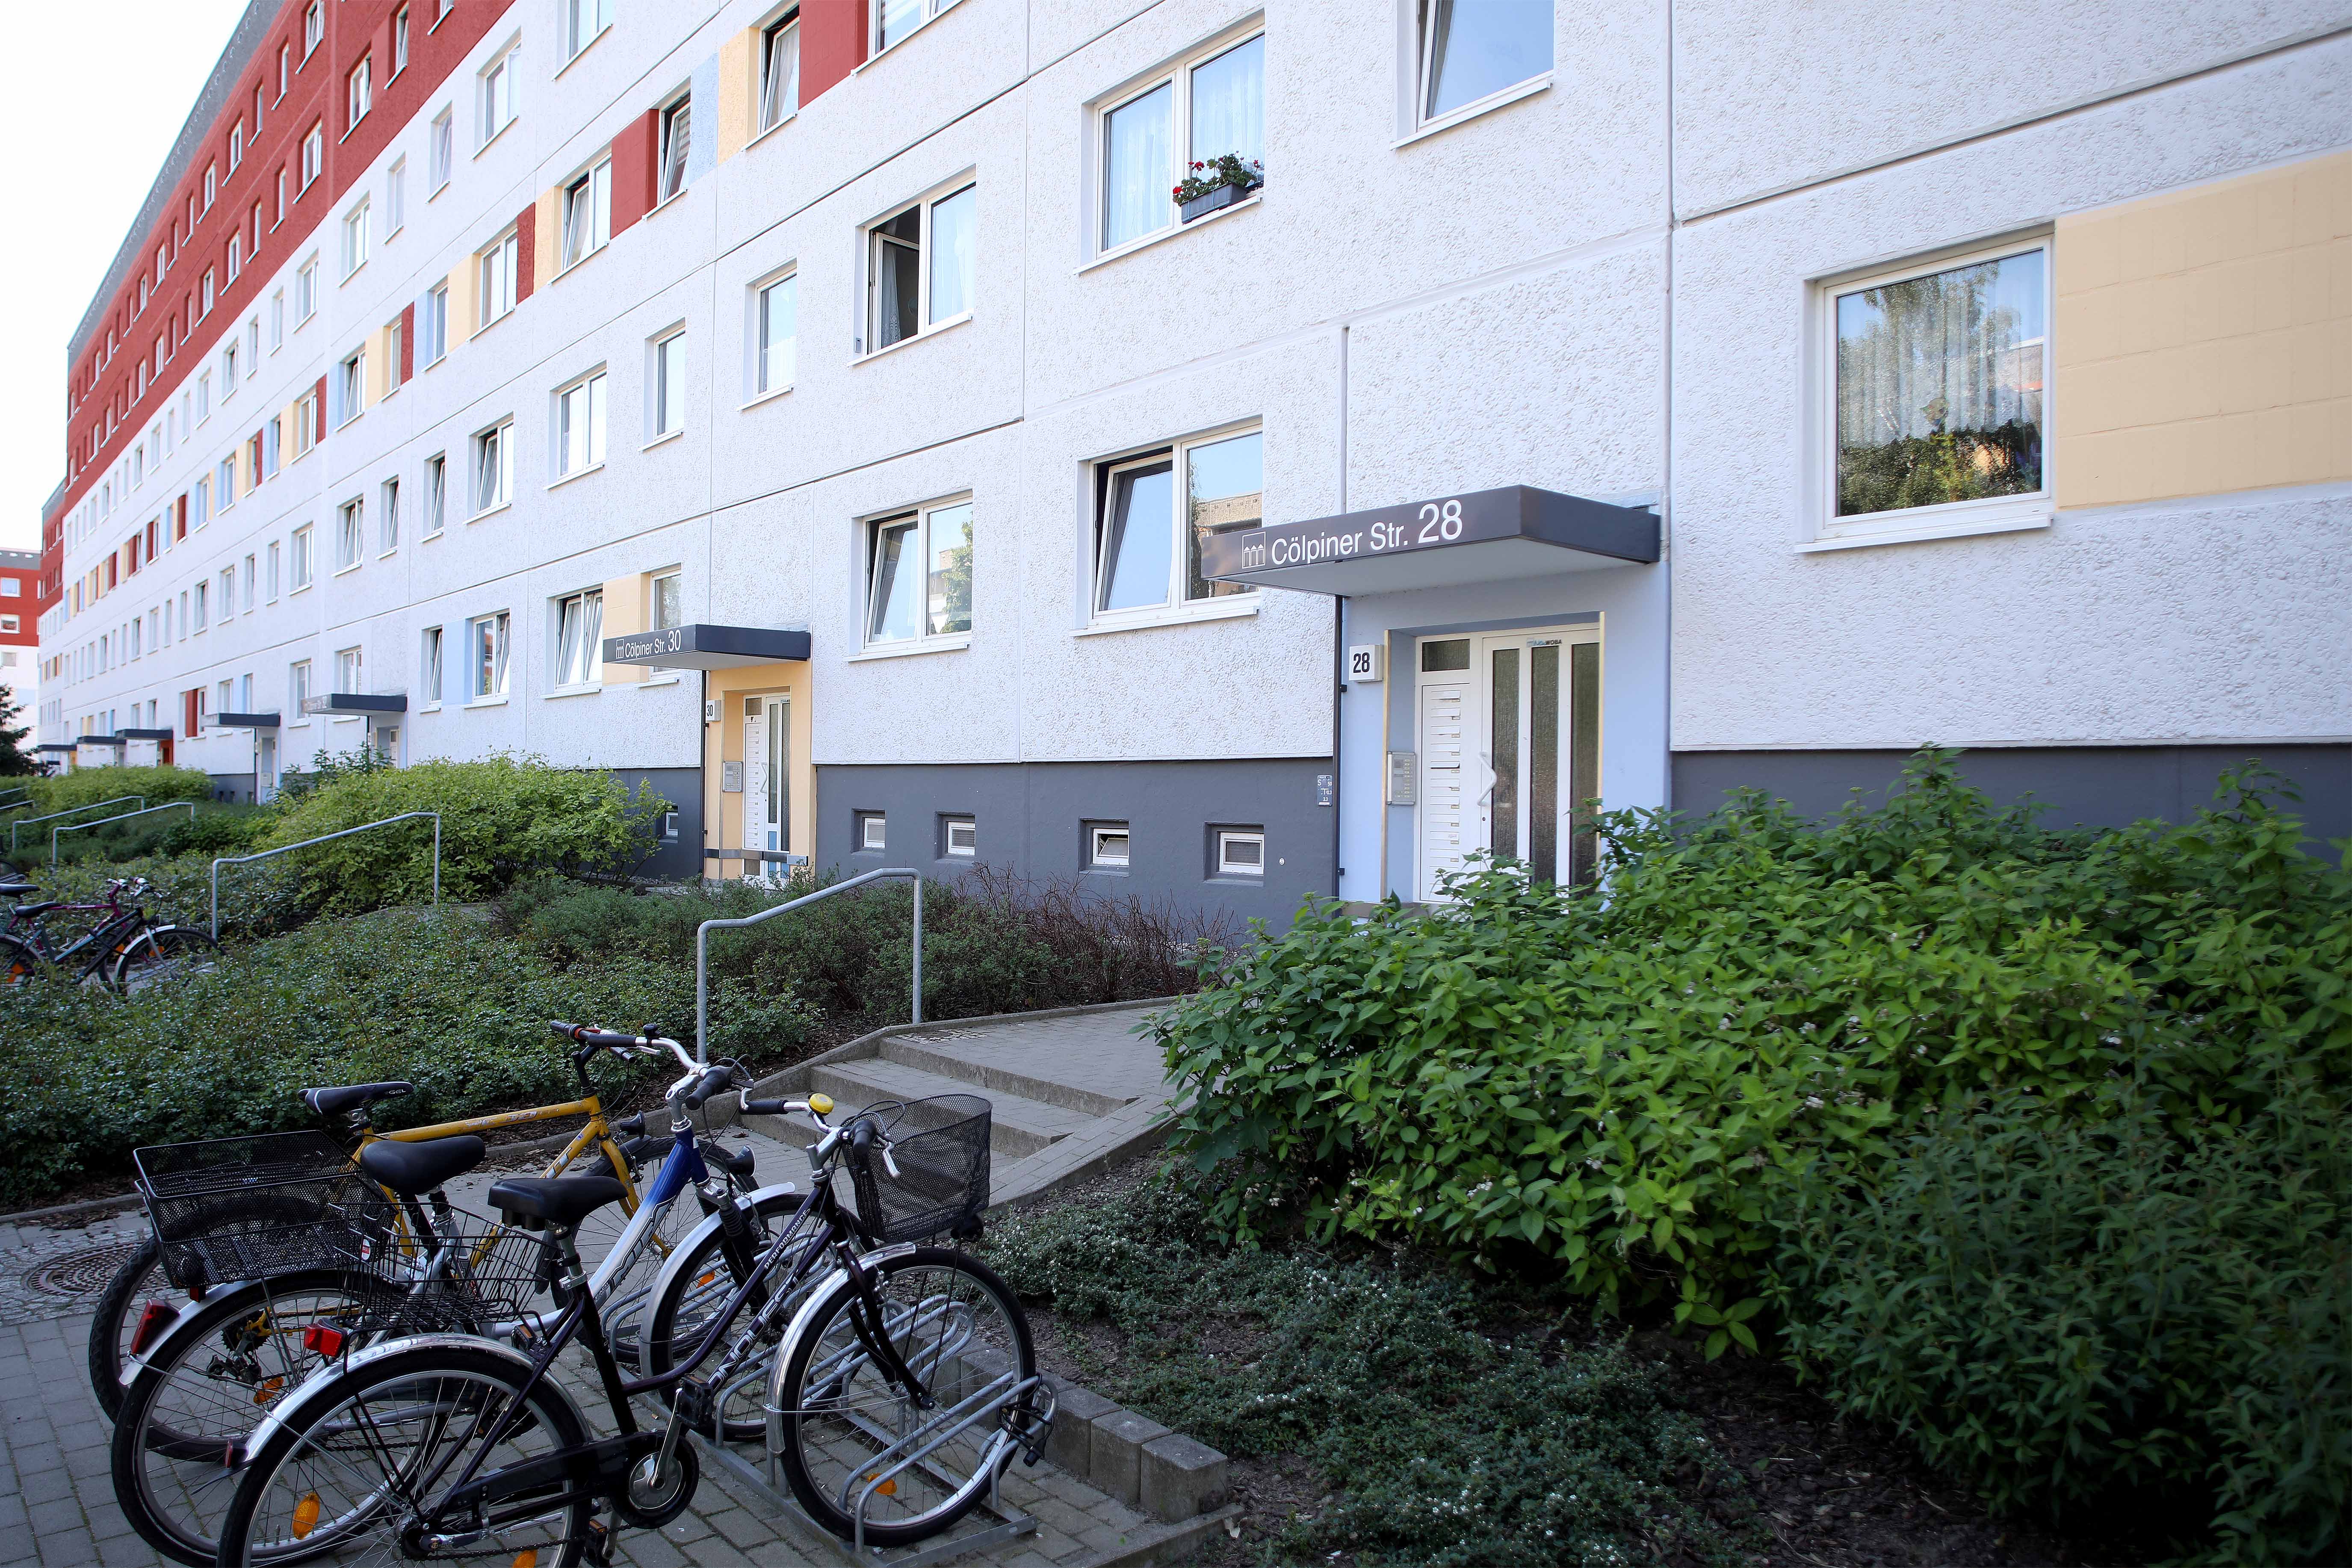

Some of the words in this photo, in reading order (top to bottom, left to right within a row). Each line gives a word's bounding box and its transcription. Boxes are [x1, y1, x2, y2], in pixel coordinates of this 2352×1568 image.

[1271, 531, 1362, 565] Cölpiner
[1370, 522, 1408, 551] Str.
[1418, 499, 1463, 544] 28
[625, 641, 653, 658] Cölpiner
[654, 638, 665, 654] Str.
[668, 629, 681, 652] 30
[1353, 652, 1370, 673] 28
[706, 705, 713, 717] 30
[764, 1208, 810, 1270] PERFORMANCE
[707, 1270, 799, 1393] ONQUEST
